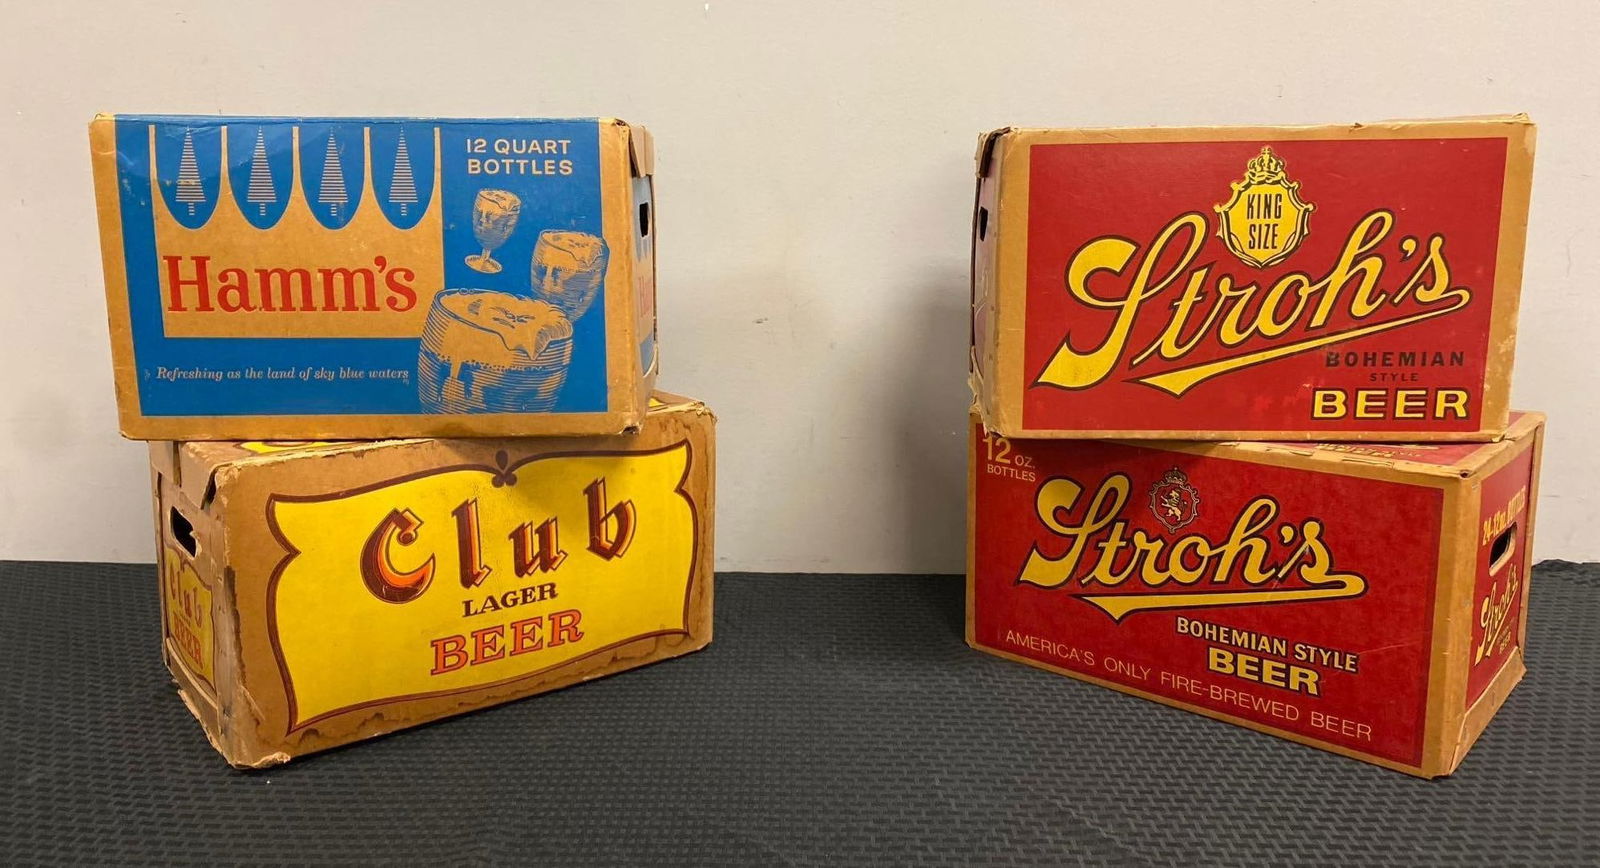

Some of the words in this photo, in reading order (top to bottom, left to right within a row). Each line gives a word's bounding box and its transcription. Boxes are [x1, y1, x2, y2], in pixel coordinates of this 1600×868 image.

[466, 138, 487, 154] 12
[494, 138, 571, 155] QUART
[467, 159, 573, 176] BOTTLES
[1247, 194, 1282, 219] KING
[1248, 223, 1279, 250] SIZE
[163, 255, 418, 314] Hamm's
[1030, 208, 1472, 398] Stroh's
[156, 366, 223, 382] Refreshing
[227, 370, 241, 379] as
[245, 366, 263, 379] the
[267, 366, 296, 379] land
[299, 367, 312, 382] of
[314, 366, 335, 382] sky
[339, 366, 365, 379] blue
[368, 368, 409, 380] waters
[1325, 351, 1464, 367] BOHEMIAN
[1370, 372, 1419, 382] STYLE
[1311, 387, 1470, 421] BEER
[983, 433, 1011, 464] 12
[1014, 454, 1036, 469] OZ.
[987, 463, 1036, 482] BOTTLES
[360, 477, 636, 604] Club
[1014, 471, 1368, 624] Stroh's
[462, 582, 558, 618] LAGER
[430, 609, 585, 676] BEER
[1176, 615, 1288, 658] BOHEMIAN
[1293, 642, 1359, 674] STYLE
[1005, 629, 1096, 666] AMERICA'S
[1103, 657, 1152, 681] ONLY
[1160, 671, 1300, 721] FIRE-BREWED
[1311, 711, 1373, 742] BEER
[1207, 646, 1322, 697] BEER
